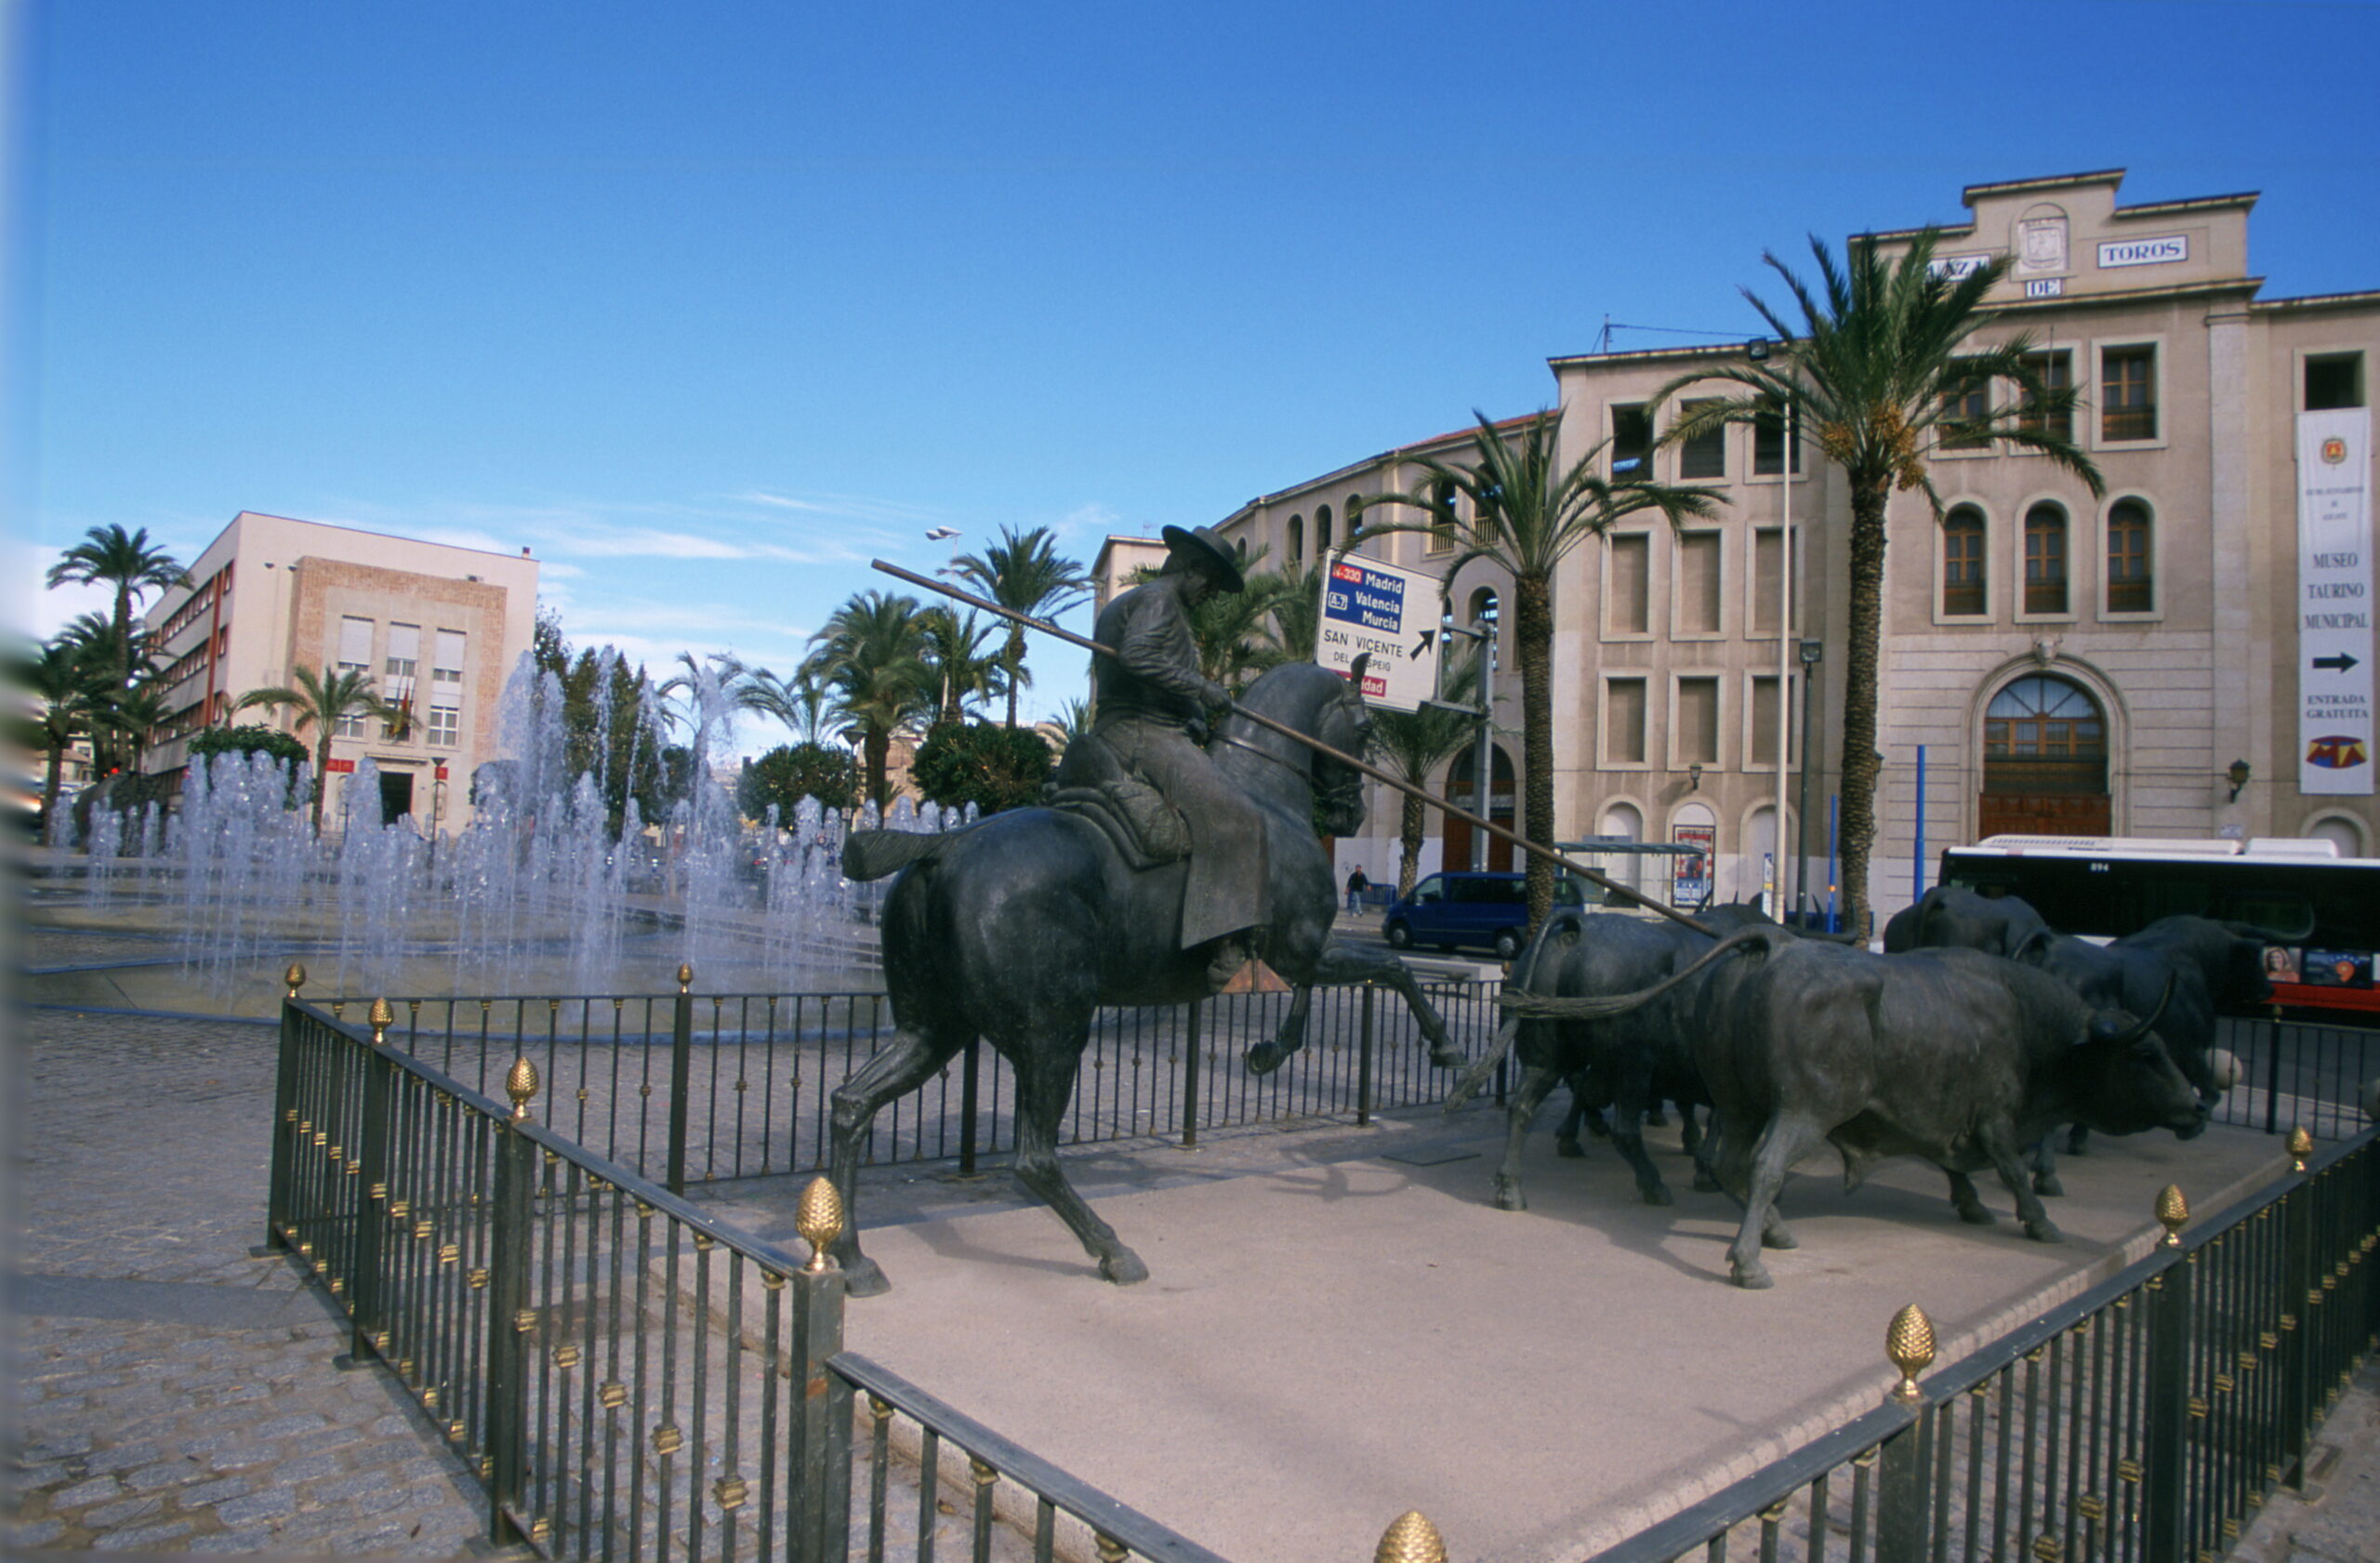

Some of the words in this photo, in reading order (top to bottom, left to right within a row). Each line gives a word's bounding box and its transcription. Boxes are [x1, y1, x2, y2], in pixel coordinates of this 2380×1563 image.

[2104, 242, 2181, 261] TOROS
[2030, 280, 2058, 296] DE
[2312, 552, 2359, 569] MUSEO
[1332, 566, 1361, 583] N-330
[1365, 572, 1403, 594] Madrid
[2307, 583, 2364, 601] TAURINO
[1330, 594, 1345, 608] A-7
[1355, 590, 1400, 614] Valencia
[1362, 610, 1398, 630] Murcia
[2305, 613, 2369, 629] MUNICIPAL
[1324, 629, 1349, 646] SAN
[1356, 636, 1403, 658] VICENTE
[1333, 651, 1350, 664] DEL
[1367, 657, 1392, 672] SPEIG
[2307, 695, 2366, 706] ENTRADA
[2306, 708, 2369, 720] GRATUITA
